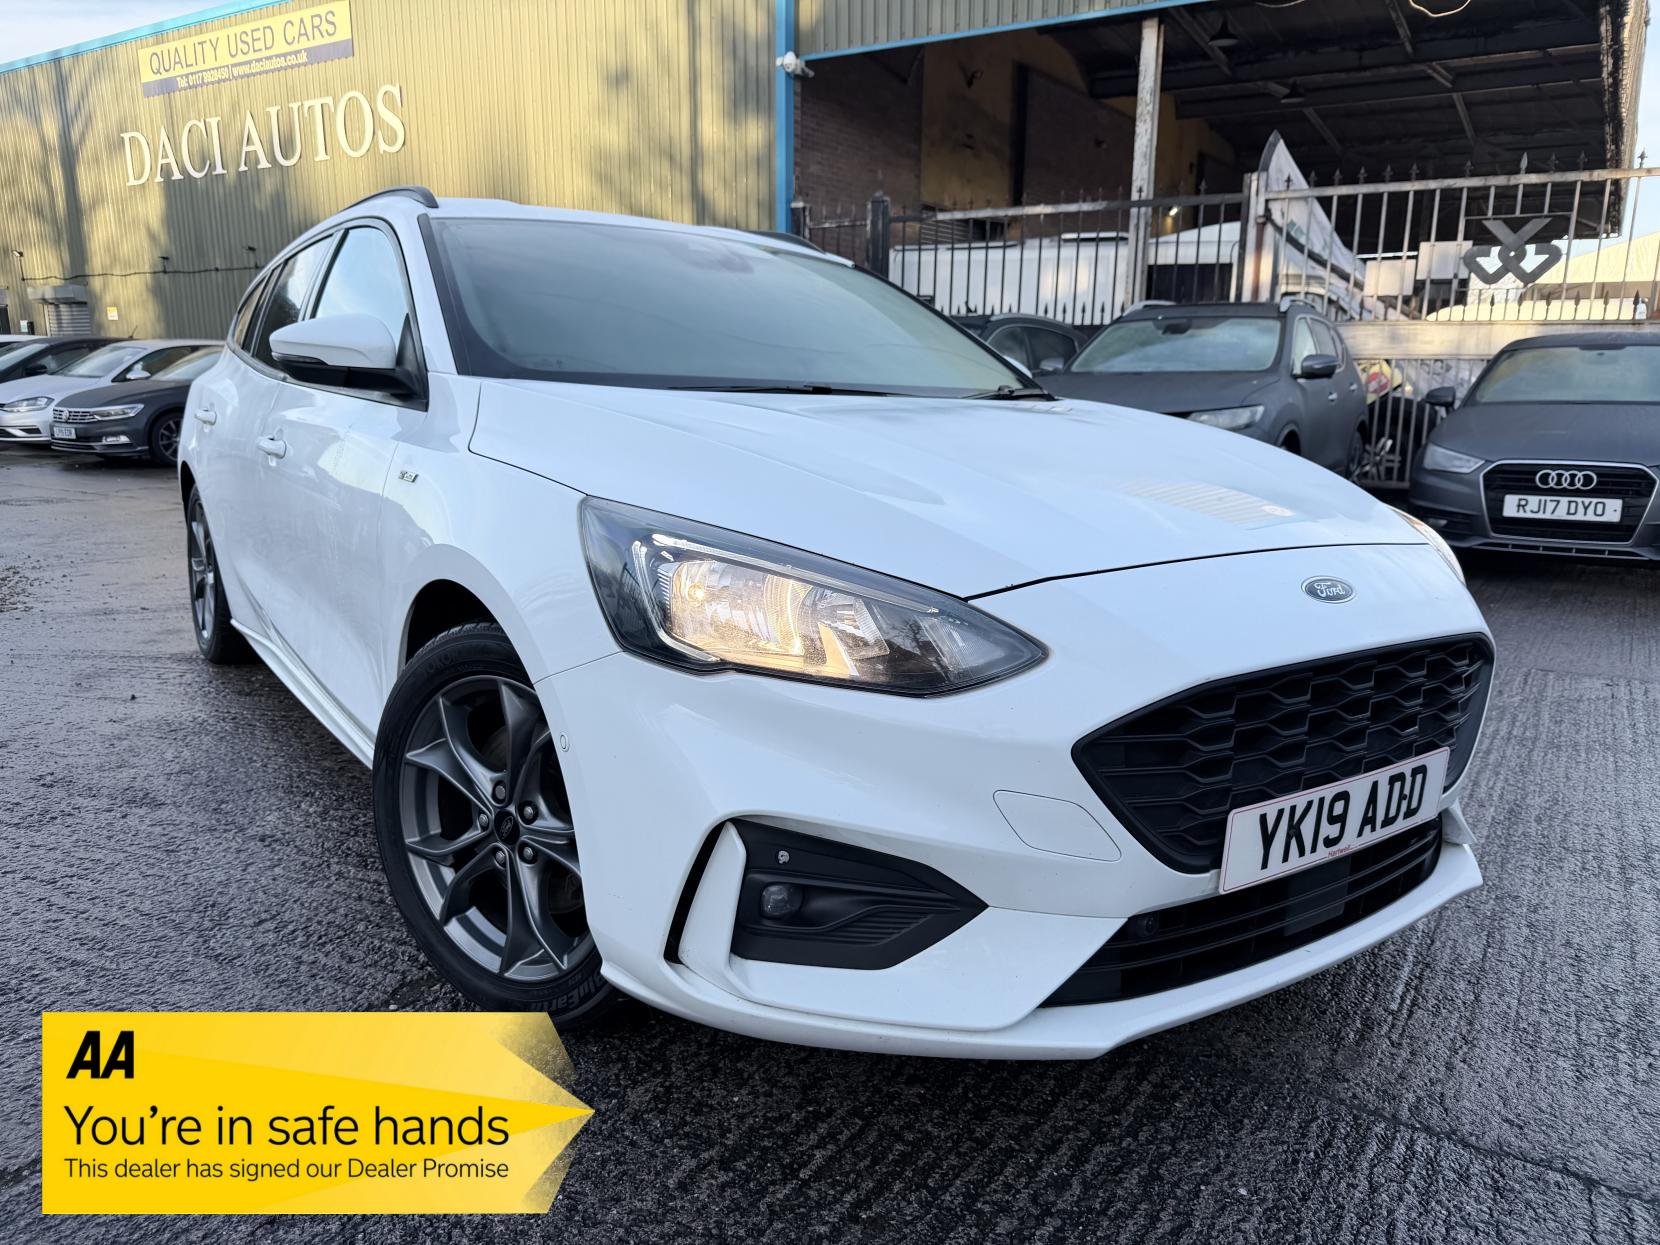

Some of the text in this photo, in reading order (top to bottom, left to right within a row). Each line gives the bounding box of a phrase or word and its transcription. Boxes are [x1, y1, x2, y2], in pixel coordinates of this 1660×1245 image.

[149, 10, 337, 76] QUALITY USED CARS
[120, 83, 405, 187] DACI AUTOS
[1516, 498, 1607, 518] RJ17 DYO
[1314, 582, 1346, 597] Ford
[1259, 764, 1428, 871] YK19 ADD
